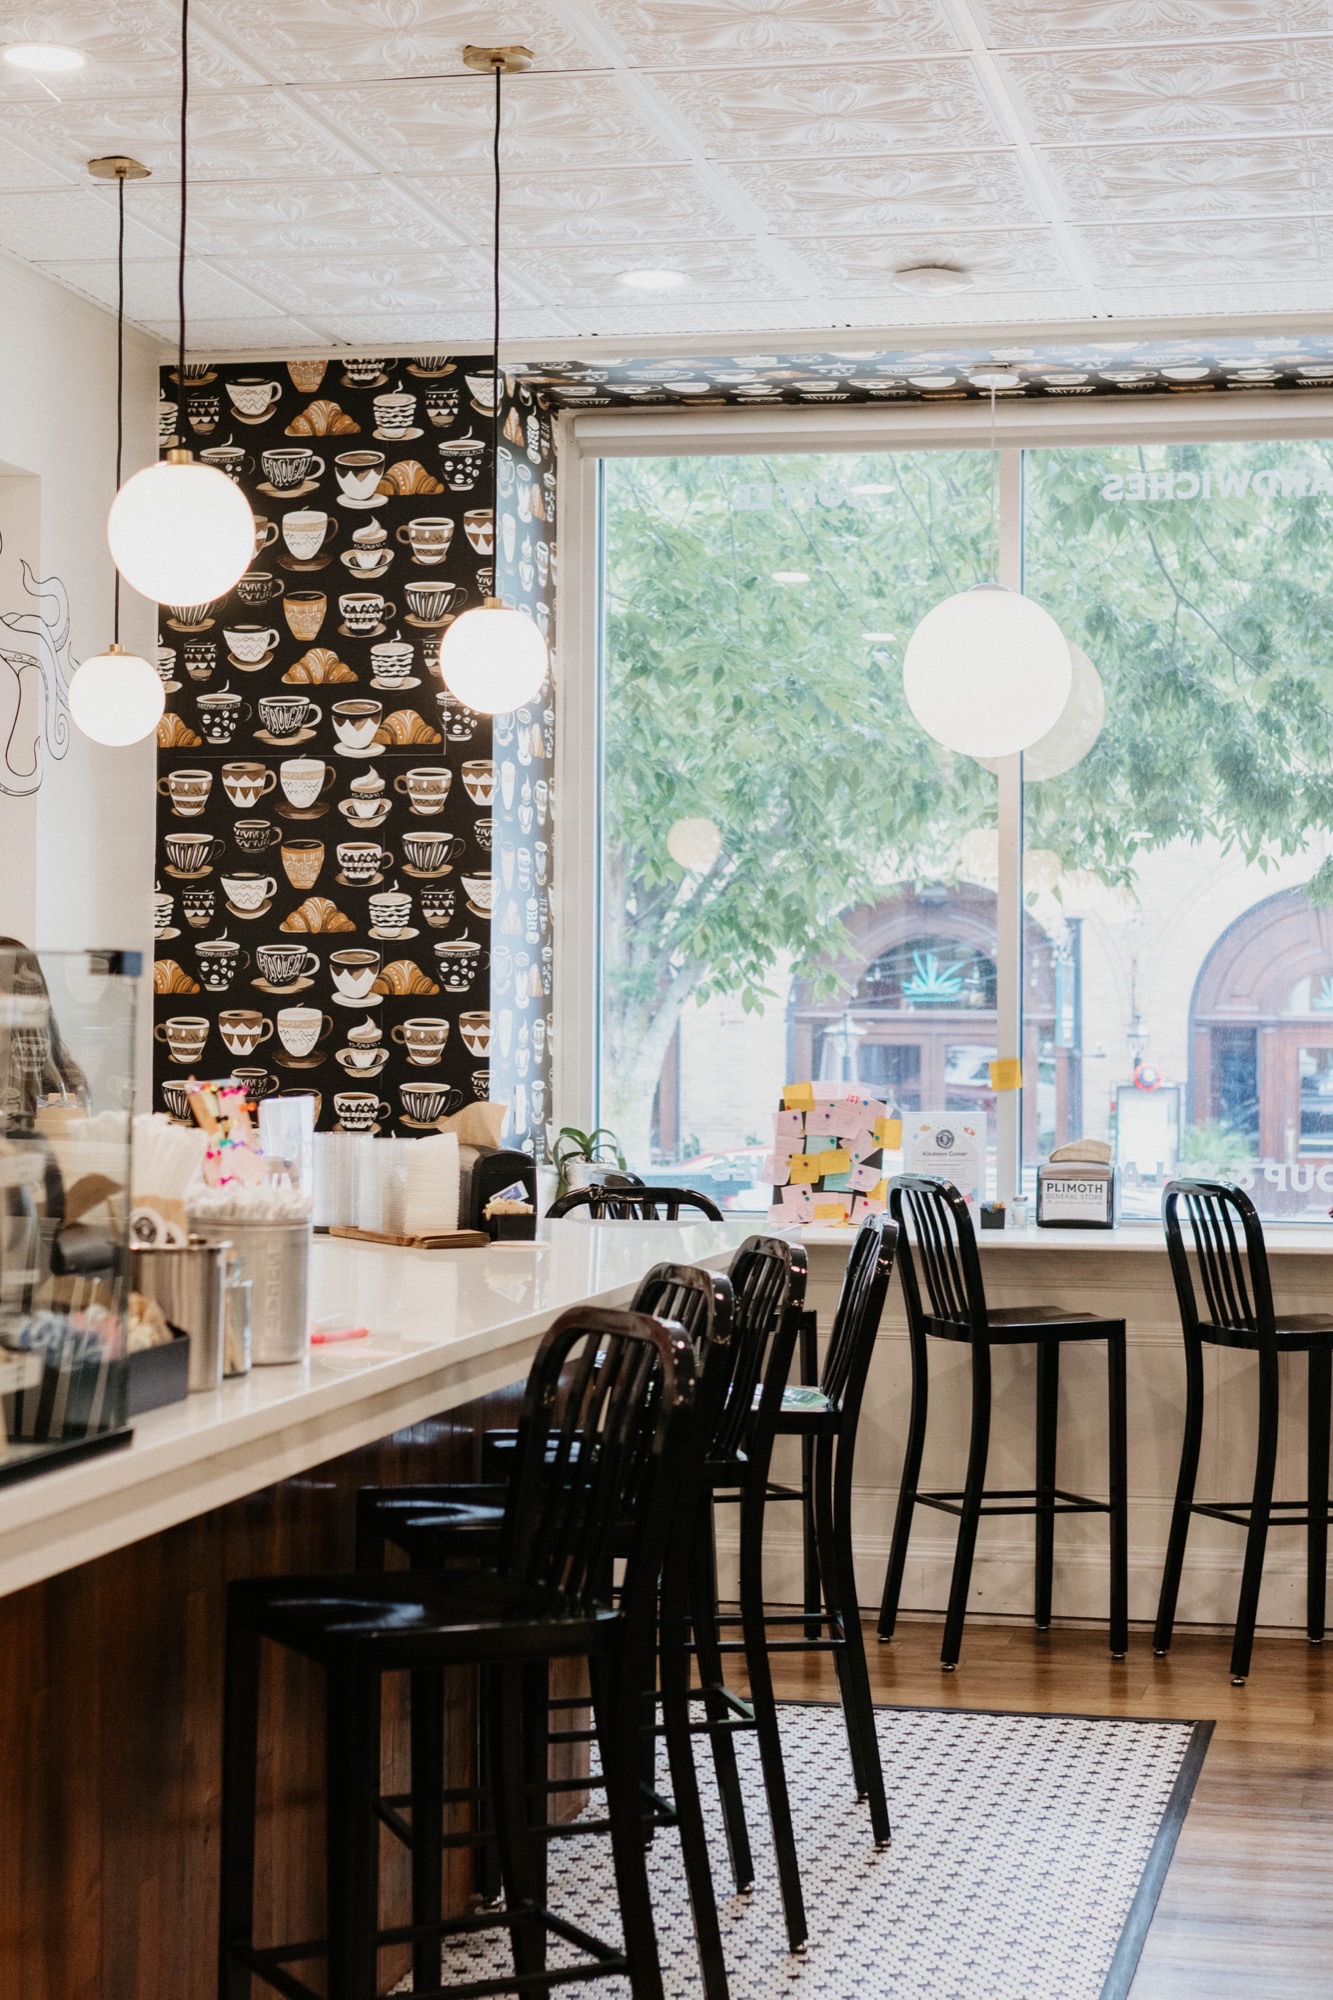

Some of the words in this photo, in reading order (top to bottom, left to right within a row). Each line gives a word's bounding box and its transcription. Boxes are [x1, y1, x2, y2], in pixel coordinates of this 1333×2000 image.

[845, 1094, 860, 1104] JOY
[1046, 1182, 1103, 1194] PLIMOTH
[1080, 1193, 1103, 1201] STORE
